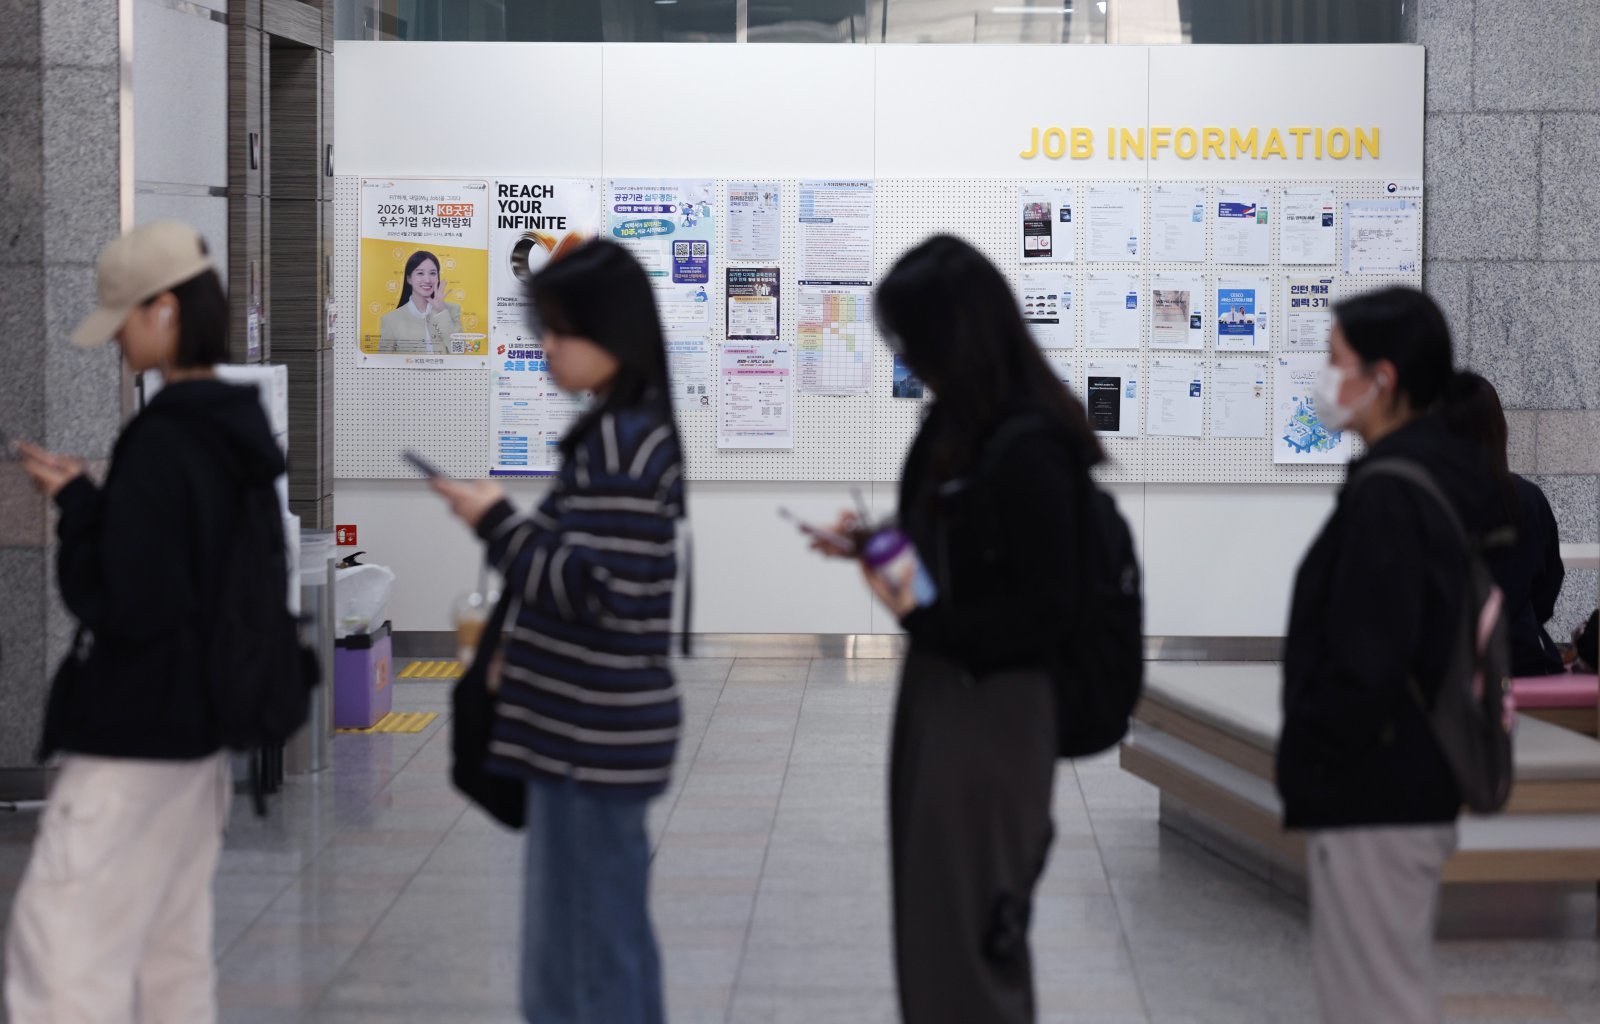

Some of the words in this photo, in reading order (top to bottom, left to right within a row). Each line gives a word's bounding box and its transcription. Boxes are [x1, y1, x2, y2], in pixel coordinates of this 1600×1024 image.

[1019, 127, 1094, 159] JOB
[1107, 127, 1380, 160] INFORMATION
[498, 185, 554, 198] REACH
[614, 193, 643, 202] 공공기관
[377, 204, 405, 215] 2026
[407, 204, 435, 215] 제1차
[438, 204, 473, 217] KB굿잡
[498, 201, 542, 213] YOUR
[378, 217, 418, 228] 우수기업
[421, 217, 472, 228] 취업박람회
[498, 216, 567, 230] INFINITE
[1290, 285, 1309, 294] 인턴
[1311, 285, 1329, 294] 채용
[1312, 298, 1329, 308] 3기
[508, 350, 544, 359] 산재예방
